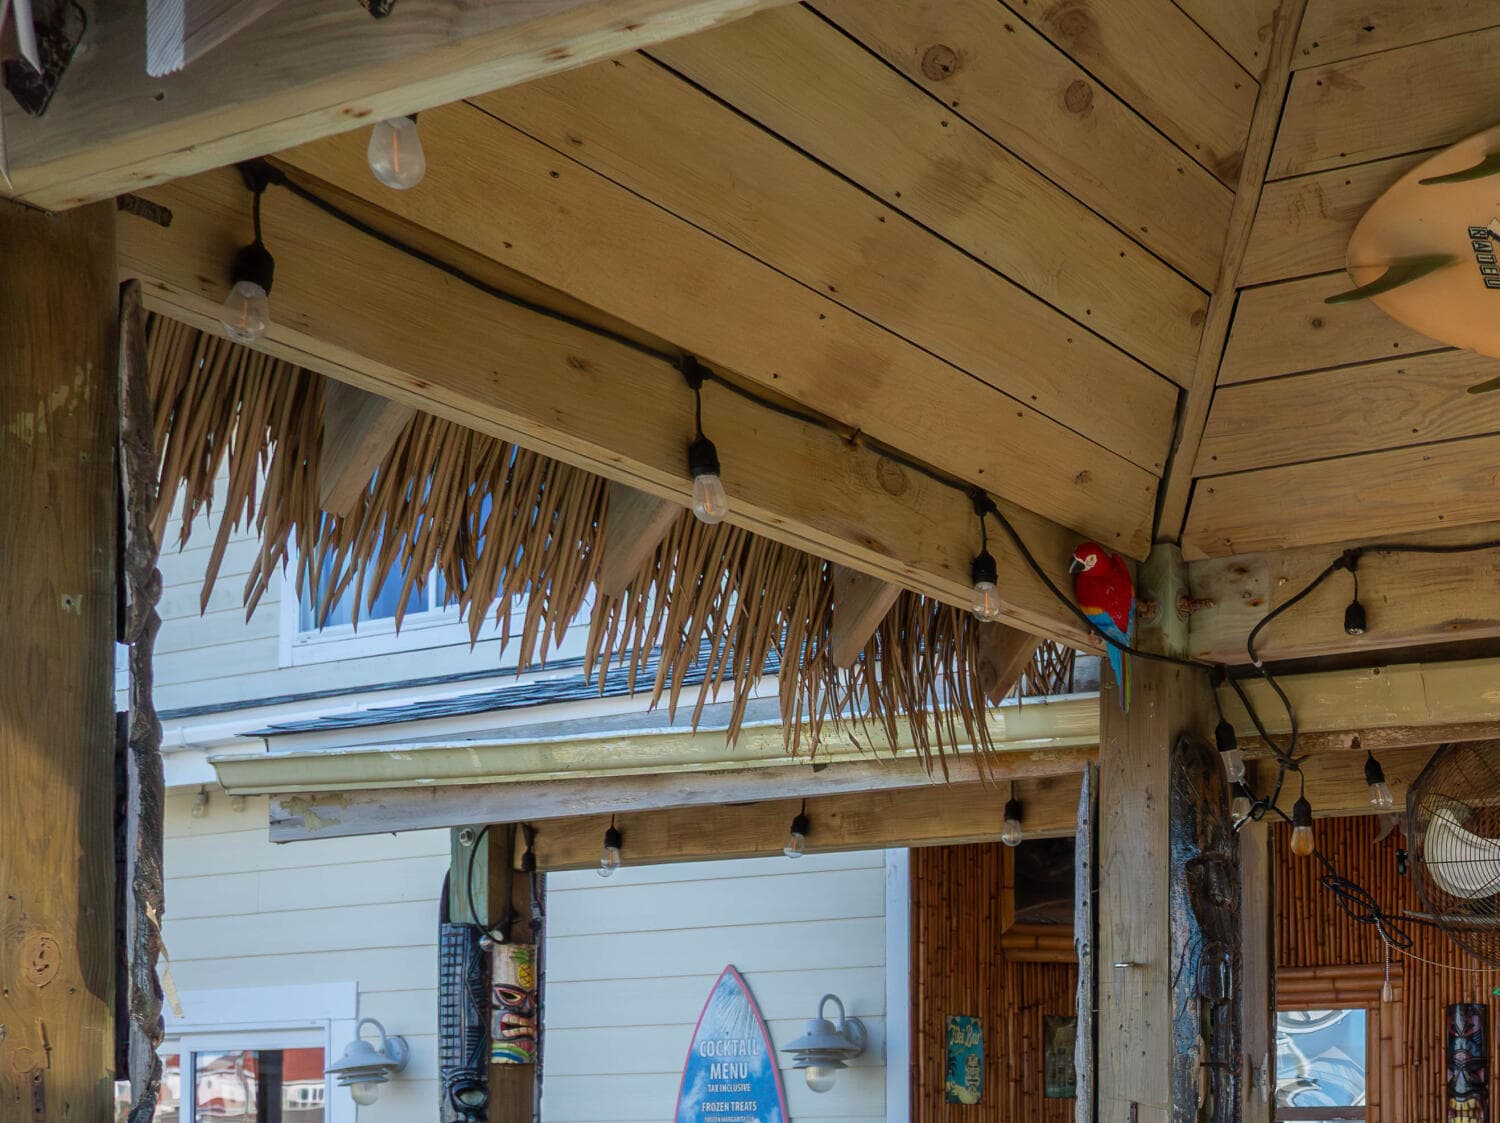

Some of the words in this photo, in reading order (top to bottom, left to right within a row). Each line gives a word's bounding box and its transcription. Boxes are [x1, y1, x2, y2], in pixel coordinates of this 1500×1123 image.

[700, 1039, 760, 1057] COCKTAIL
[710, 1062, 748, 1080] MENU
[707, 1084, 719, 1093] TAX
[720, 1083, 752, 1092] INCLUSIVE
[702, 1102, 730, 1112] FROZEN
[731, 1101, 758, 1112] TREATS
